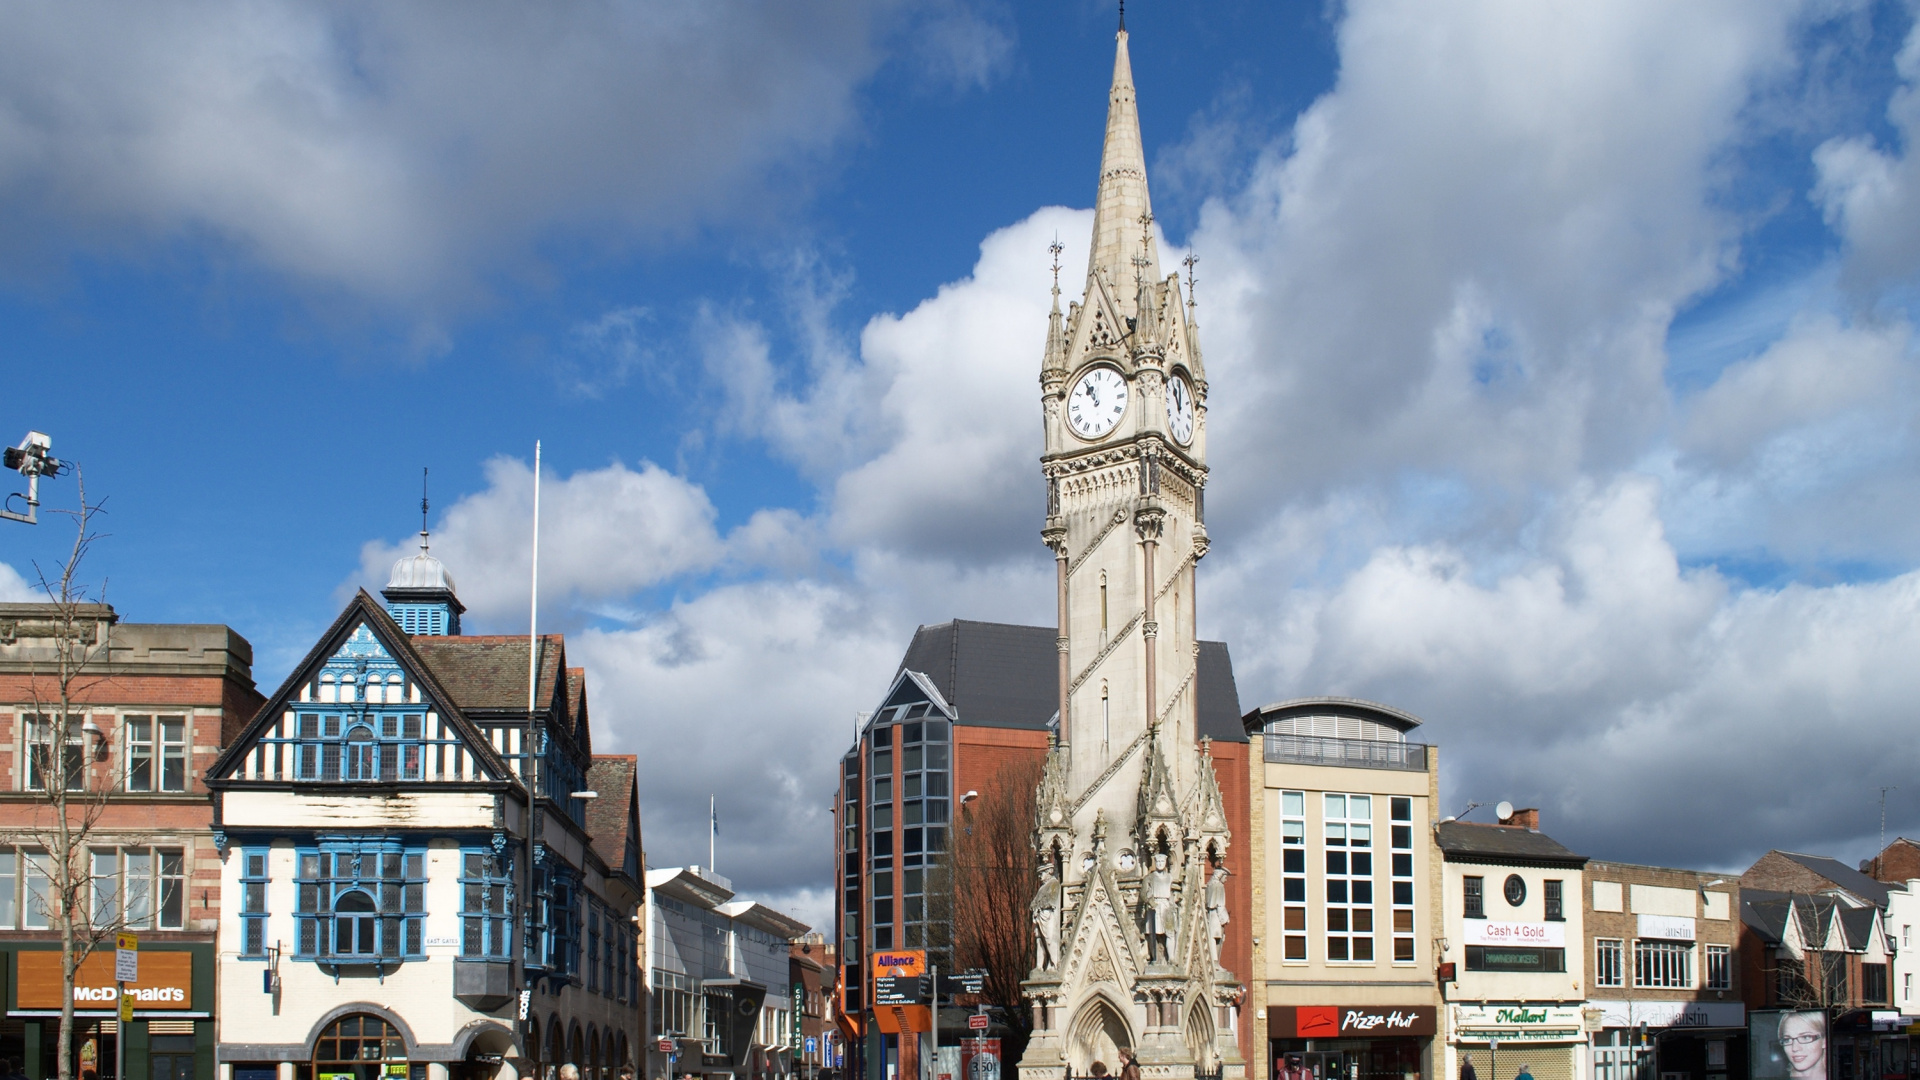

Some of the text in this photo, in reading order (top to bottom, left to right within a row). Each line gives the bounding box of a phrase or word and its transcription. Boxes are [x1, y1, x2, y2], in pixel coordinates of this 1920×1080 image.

[1487, 924, 1544, 937] Cash 4 Gold
[878, 955, 915, 967] Alliance
[519, 990, 531, 1020] scotts
[1341, 1010, 1420, 1031] Pizza Hut
[1496, 1008, 1547, 1023] Mallard
